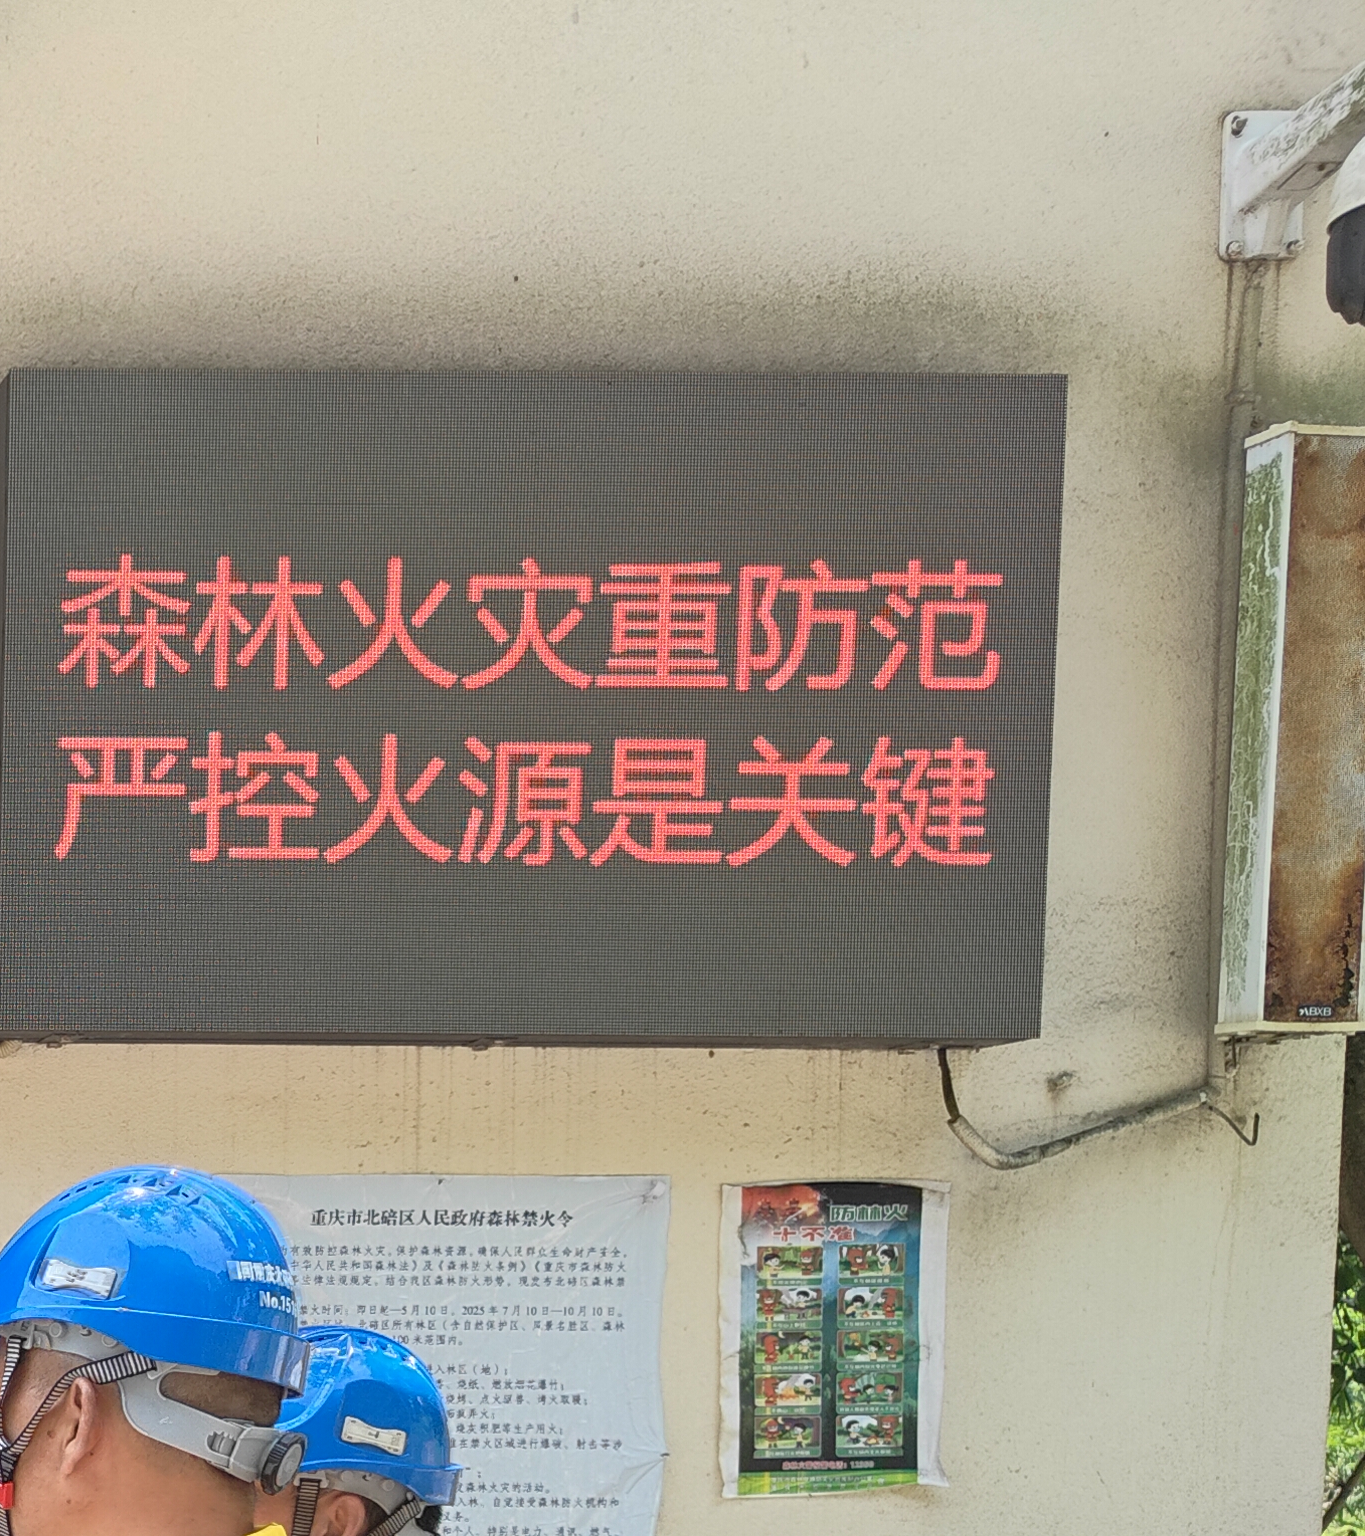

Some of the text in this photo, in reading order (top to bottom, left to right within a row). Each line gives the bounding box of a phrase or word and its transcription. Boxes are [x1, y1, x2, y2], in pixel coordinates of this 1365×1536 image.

[56, 552, 1004, 692] 森林火灾重防范
[54, 731, 995, 868] 严控火源是关键
[309, 1209, 574, 1229] 重庆市北碚区人民政府森林禁火令
[772, 1225, 855, 1243] 十不准
